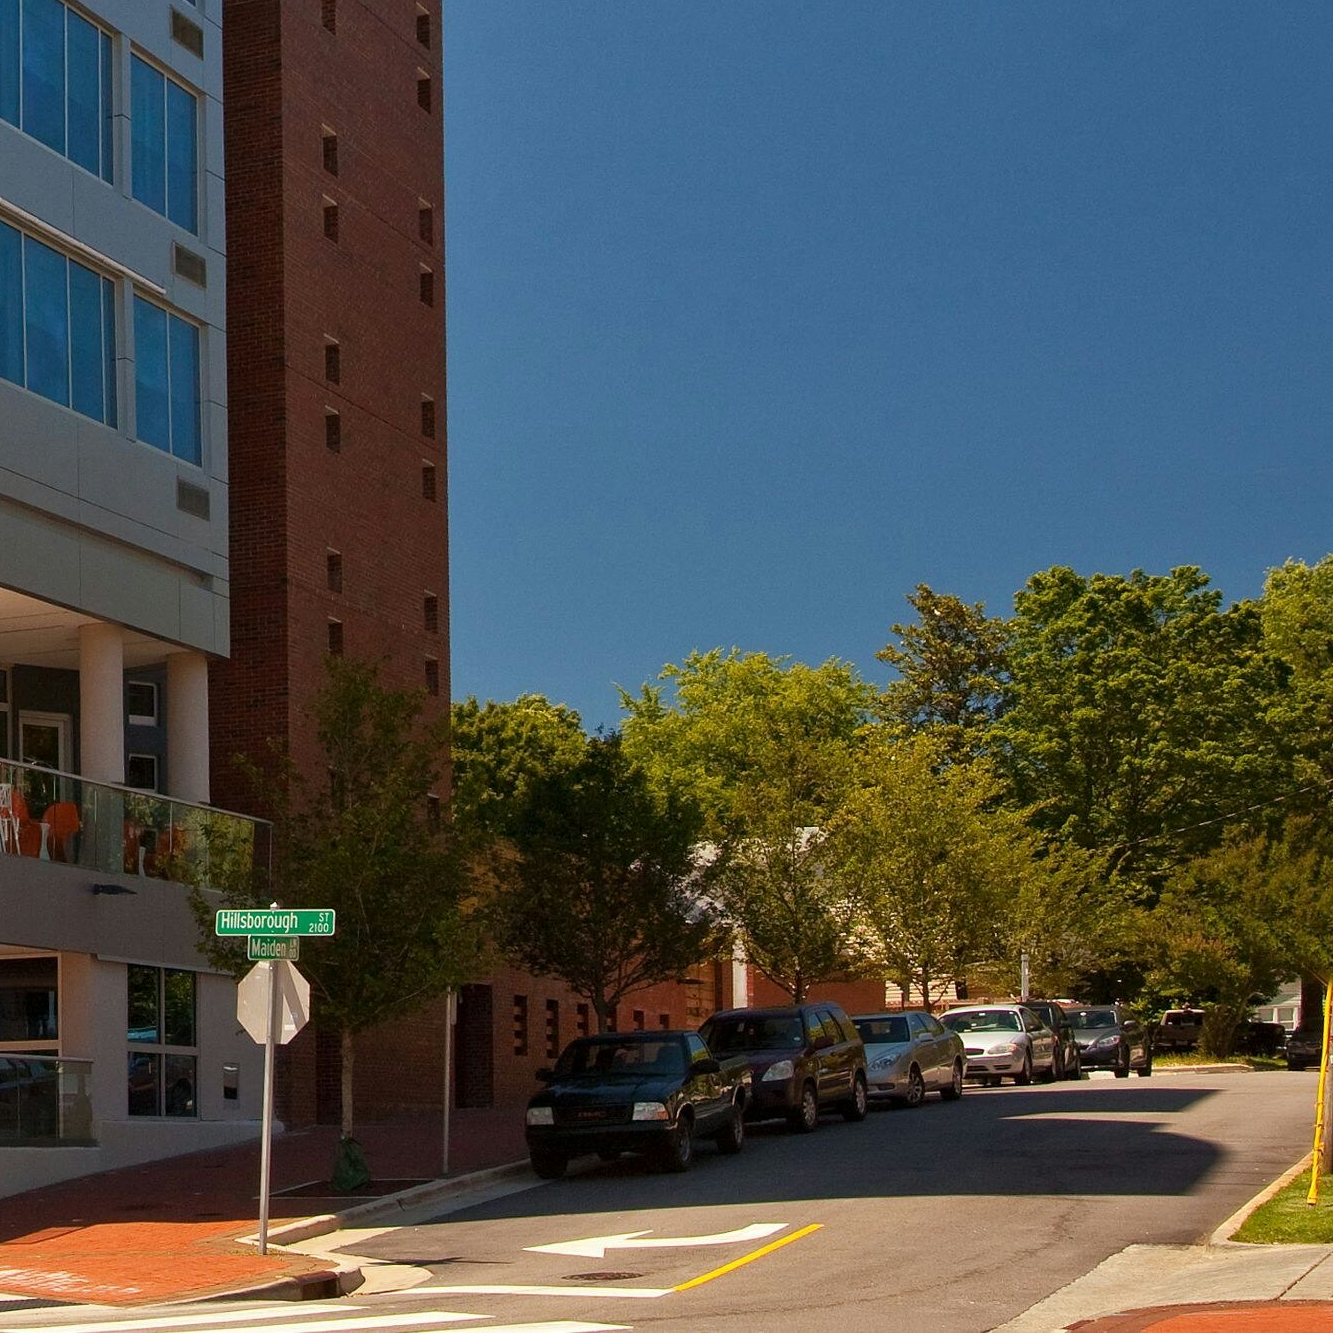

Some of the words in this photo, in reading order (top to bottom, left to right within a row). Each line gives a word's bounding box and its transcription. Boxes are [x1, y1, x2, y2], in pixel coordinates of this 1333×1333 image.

[220, 912, 299, 934] Hillsborough
[318, 912, 330, 923] ST
[308, 923, 329, 933] 2100
[251, 938, 287, 957] Maiden
